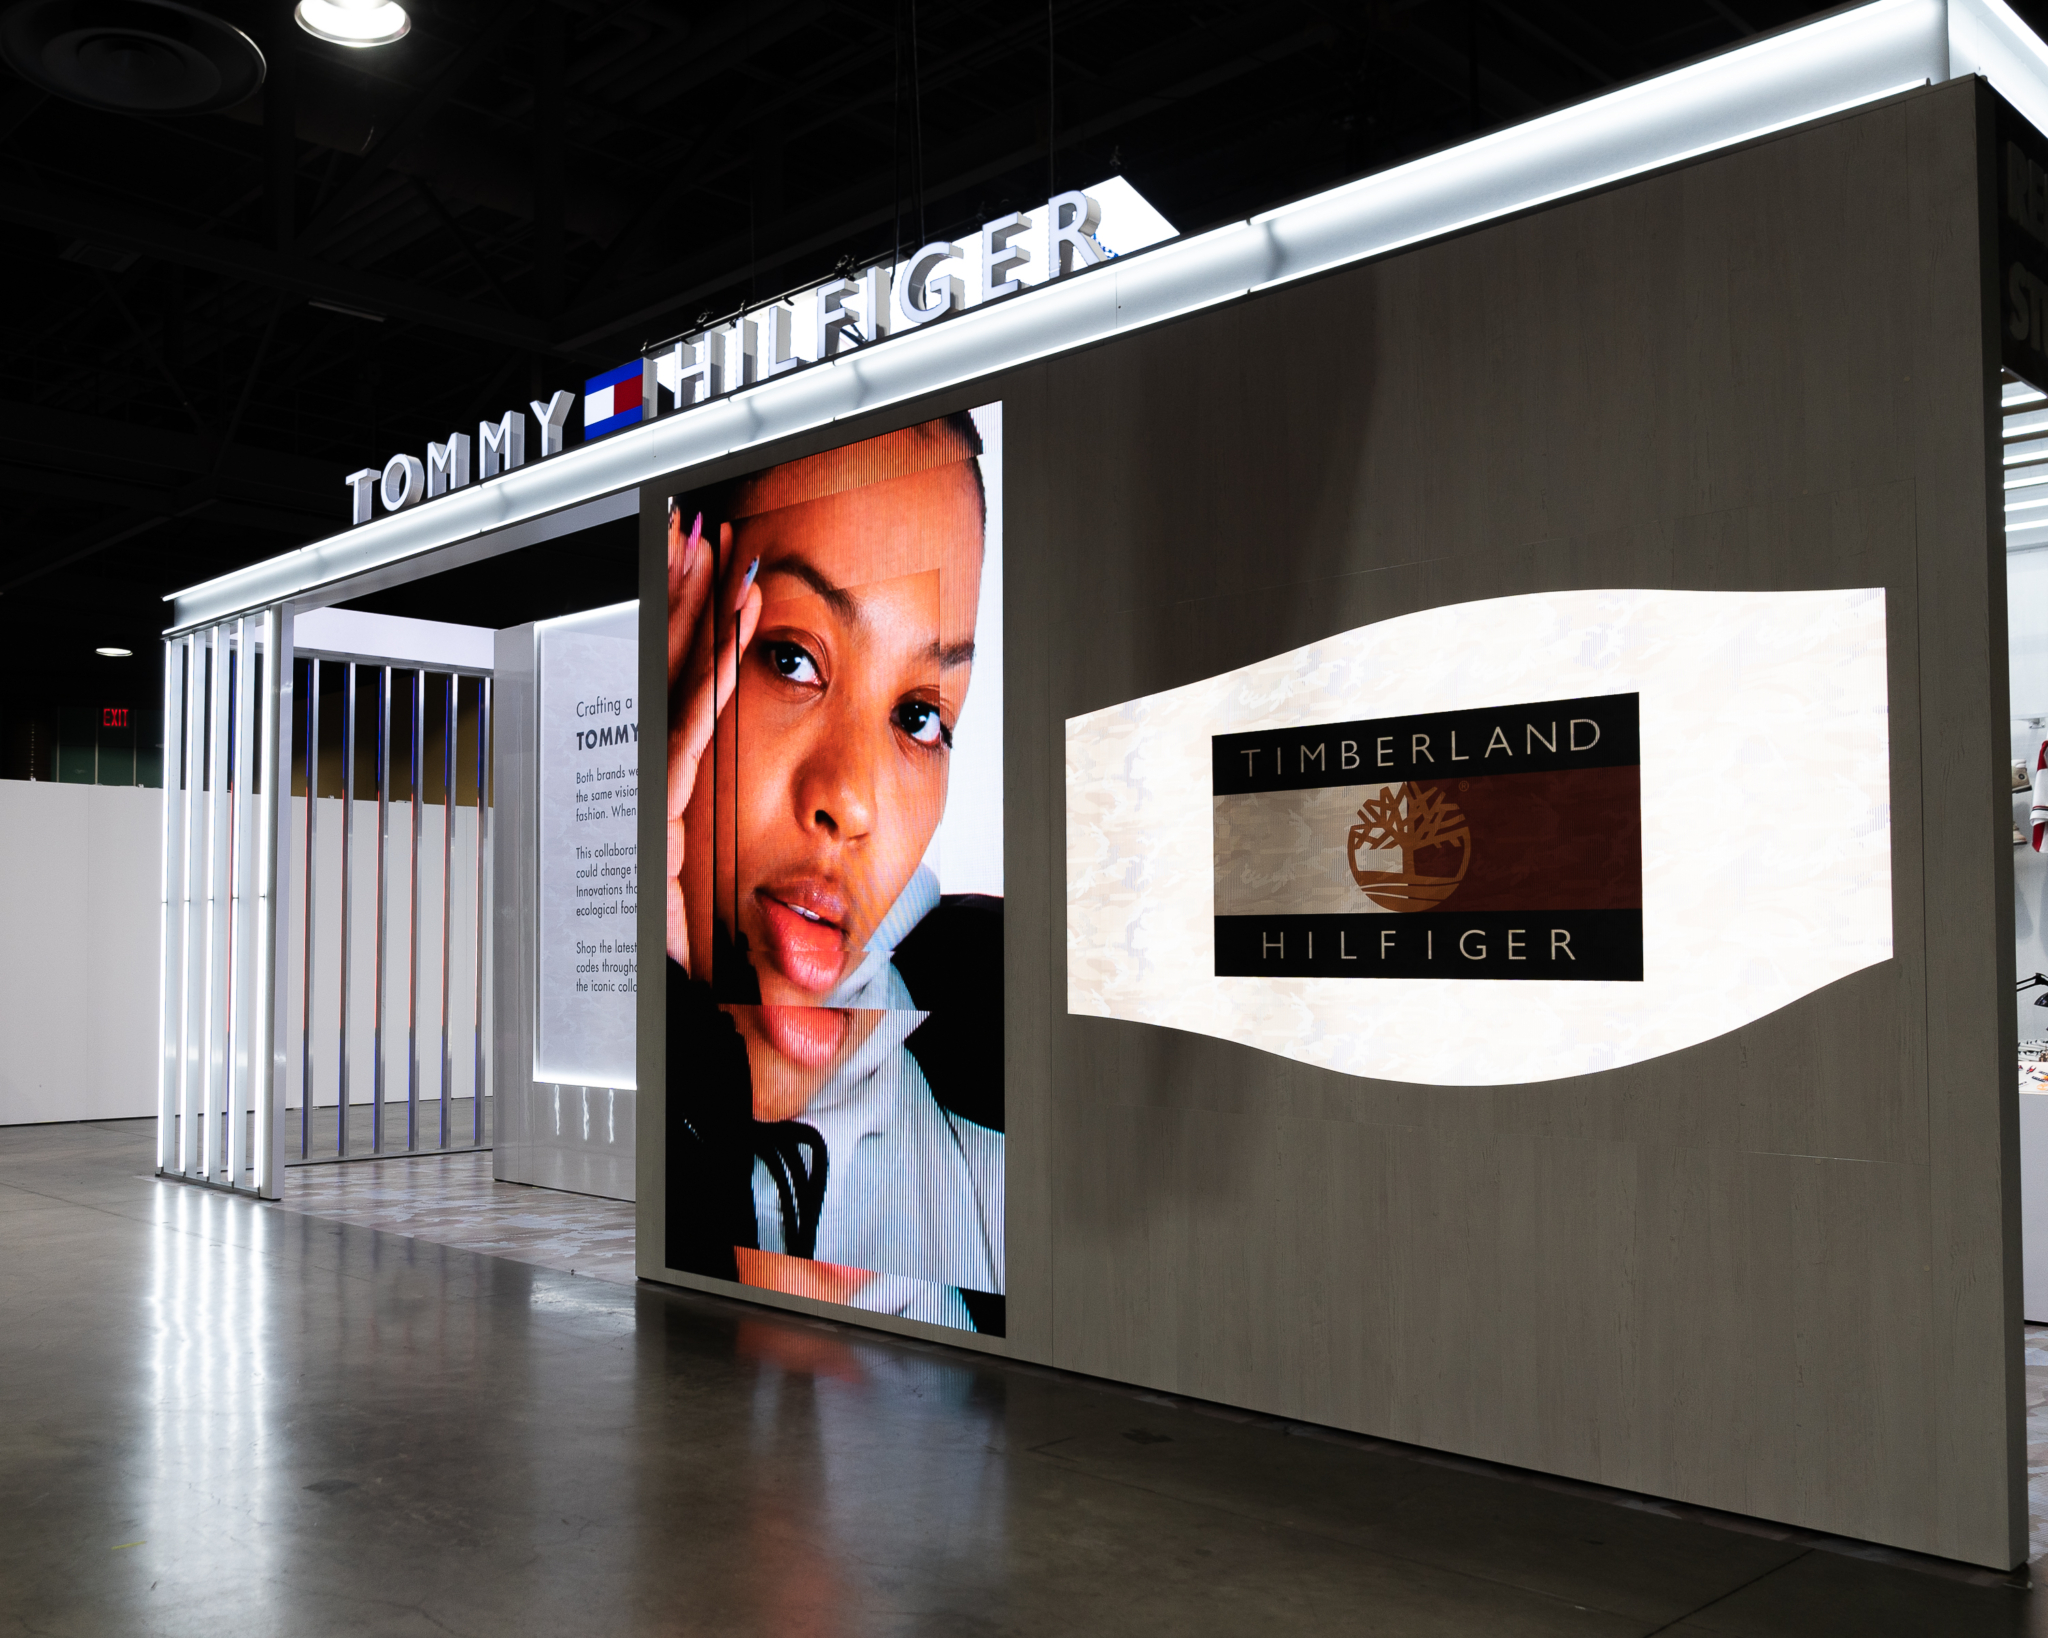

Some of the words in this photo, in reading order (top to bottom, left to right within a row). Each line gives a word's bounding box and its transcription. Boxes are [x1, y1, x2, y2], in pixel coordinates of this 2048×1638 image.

[2007, 140, 2048, 248] RE
[2009, 261, 2048, 360] ST
[346, 389, 576, 526] TOMMY
[674, 189, 1107, 410] HILFIGER
[576, 695, 621, 717] Crafting
[625, 697, 633, 709] a
[103, 708, 129, 727] EXIT
[576, 723, 638, 751] TOMMY
[1240, 718, 1601, 778] TIMBERLAND
[576, 768, 594, 784] Both
[596, 764, 626, 781] brands
[576, 789, 589, 803] the
[591, 790, 613, 801] same
[576, 806, 608, 822] fashion.
[611, 802, 637, 817] When
[576, 845, 592, 860] This
[594, 842, 637, 858] collaborat
[576, 862, 598, 879] could
[600, 862, 632, 879] change
[576, 883, 623, 897] Innovations
[576, 900, 618, 919] ecological
[576, 940, 597, 957] Shop
[599, 939, 612, 953] the
[614, 938, 638, 953] latest
[1262, 928, 1577, 961] HILFIGER
[576, 958, 599, 973] codes
[576, 977, 589, 992] the
[591, 979, 615, 992] iconic
